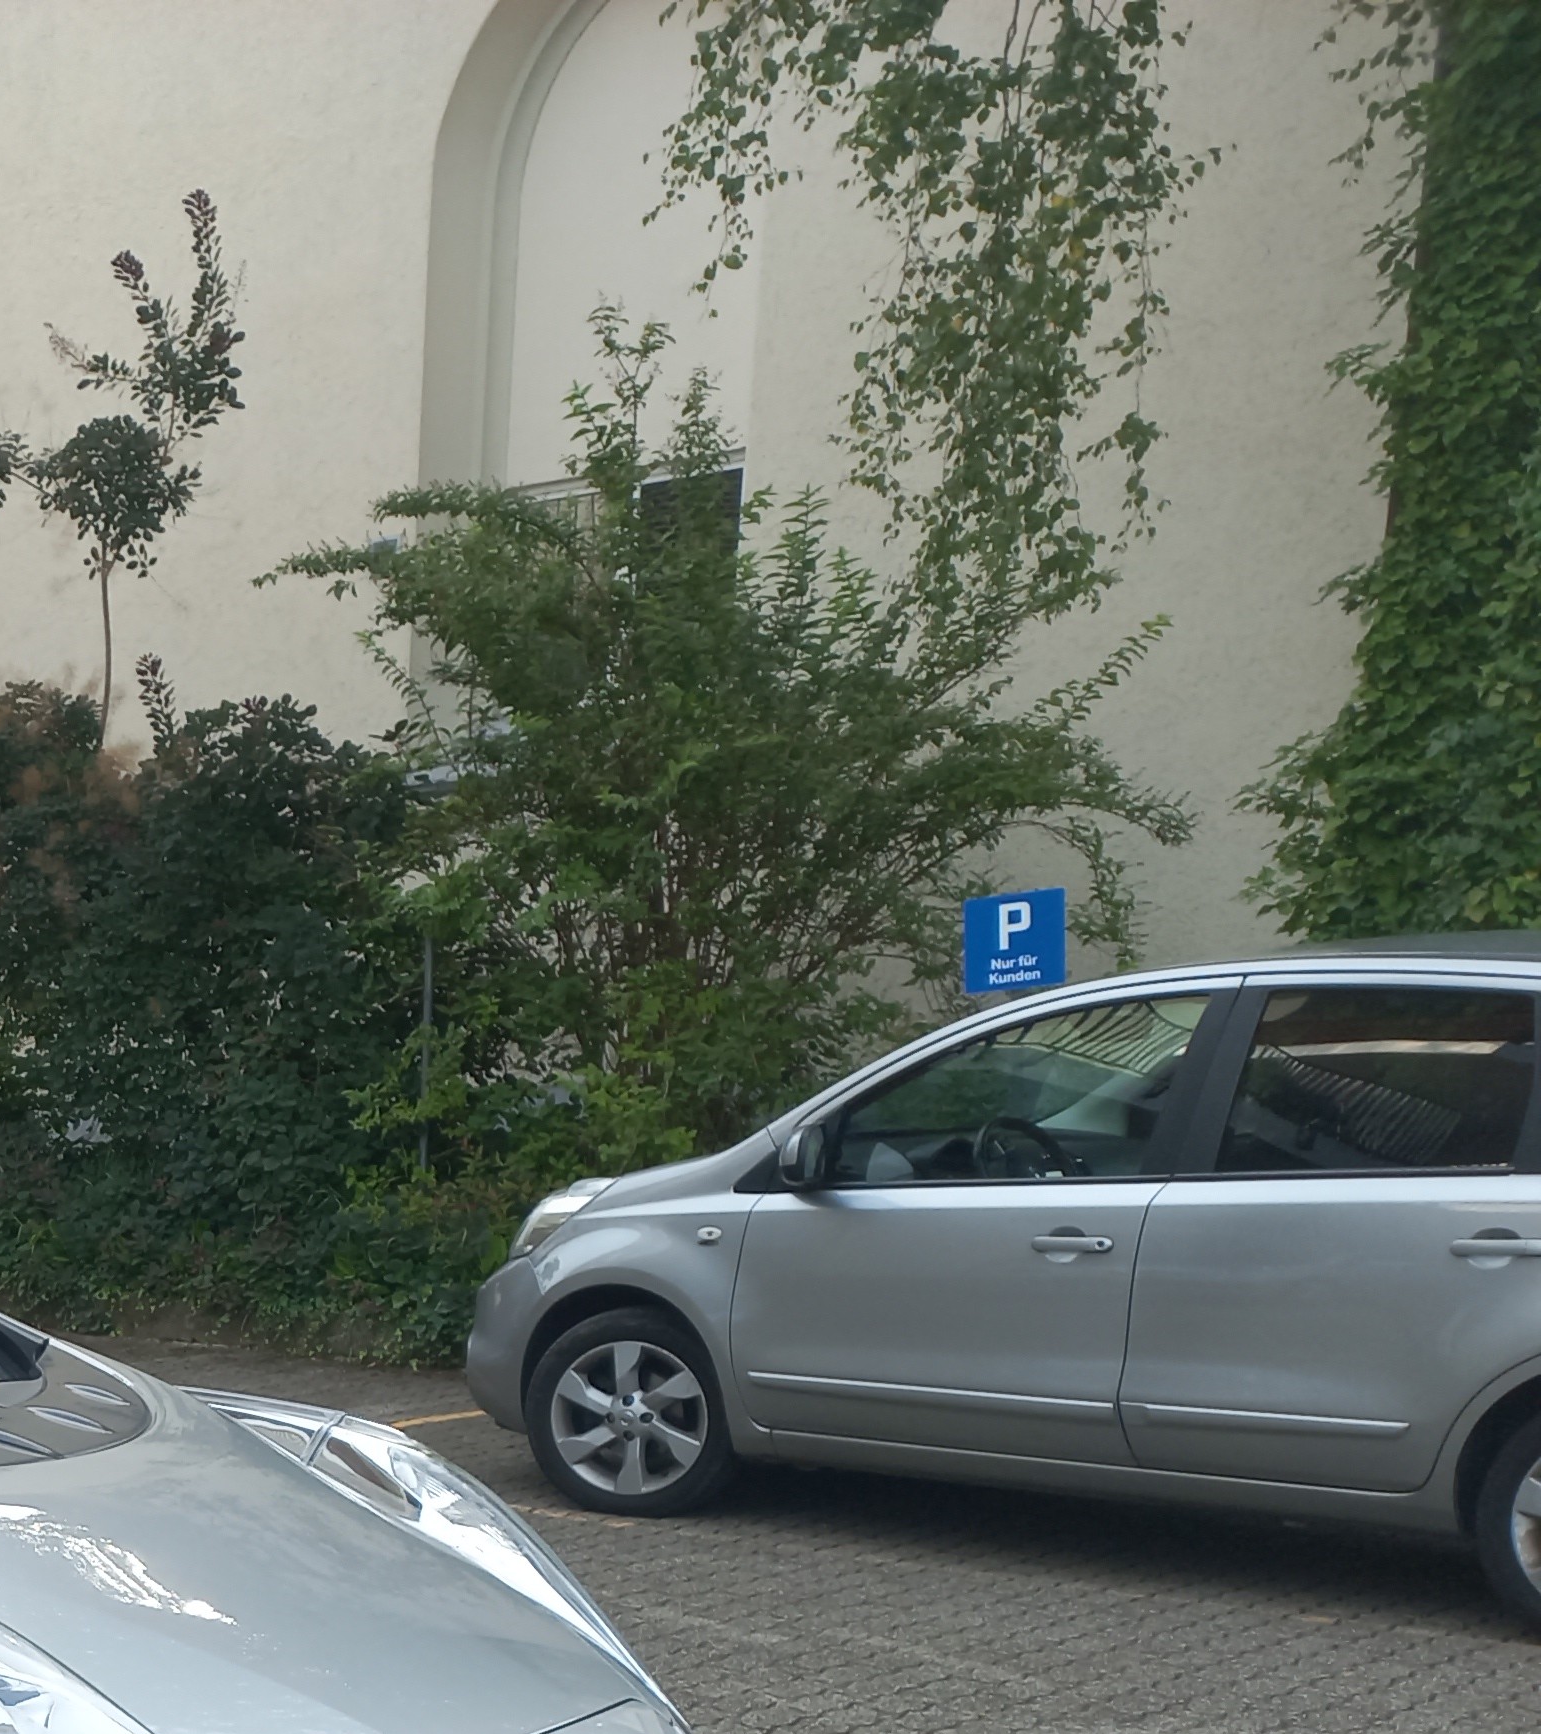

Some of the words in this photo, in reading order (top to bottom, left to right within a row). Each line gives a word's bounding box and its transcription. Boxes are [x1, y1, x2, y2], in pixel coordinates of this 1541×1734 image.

[998, 901, 1032, 951] P
[990, 958, 1017, 970] Nur
[1017, 954, 1038, 967] für
[989, 969, 1040, 985] Kunden
